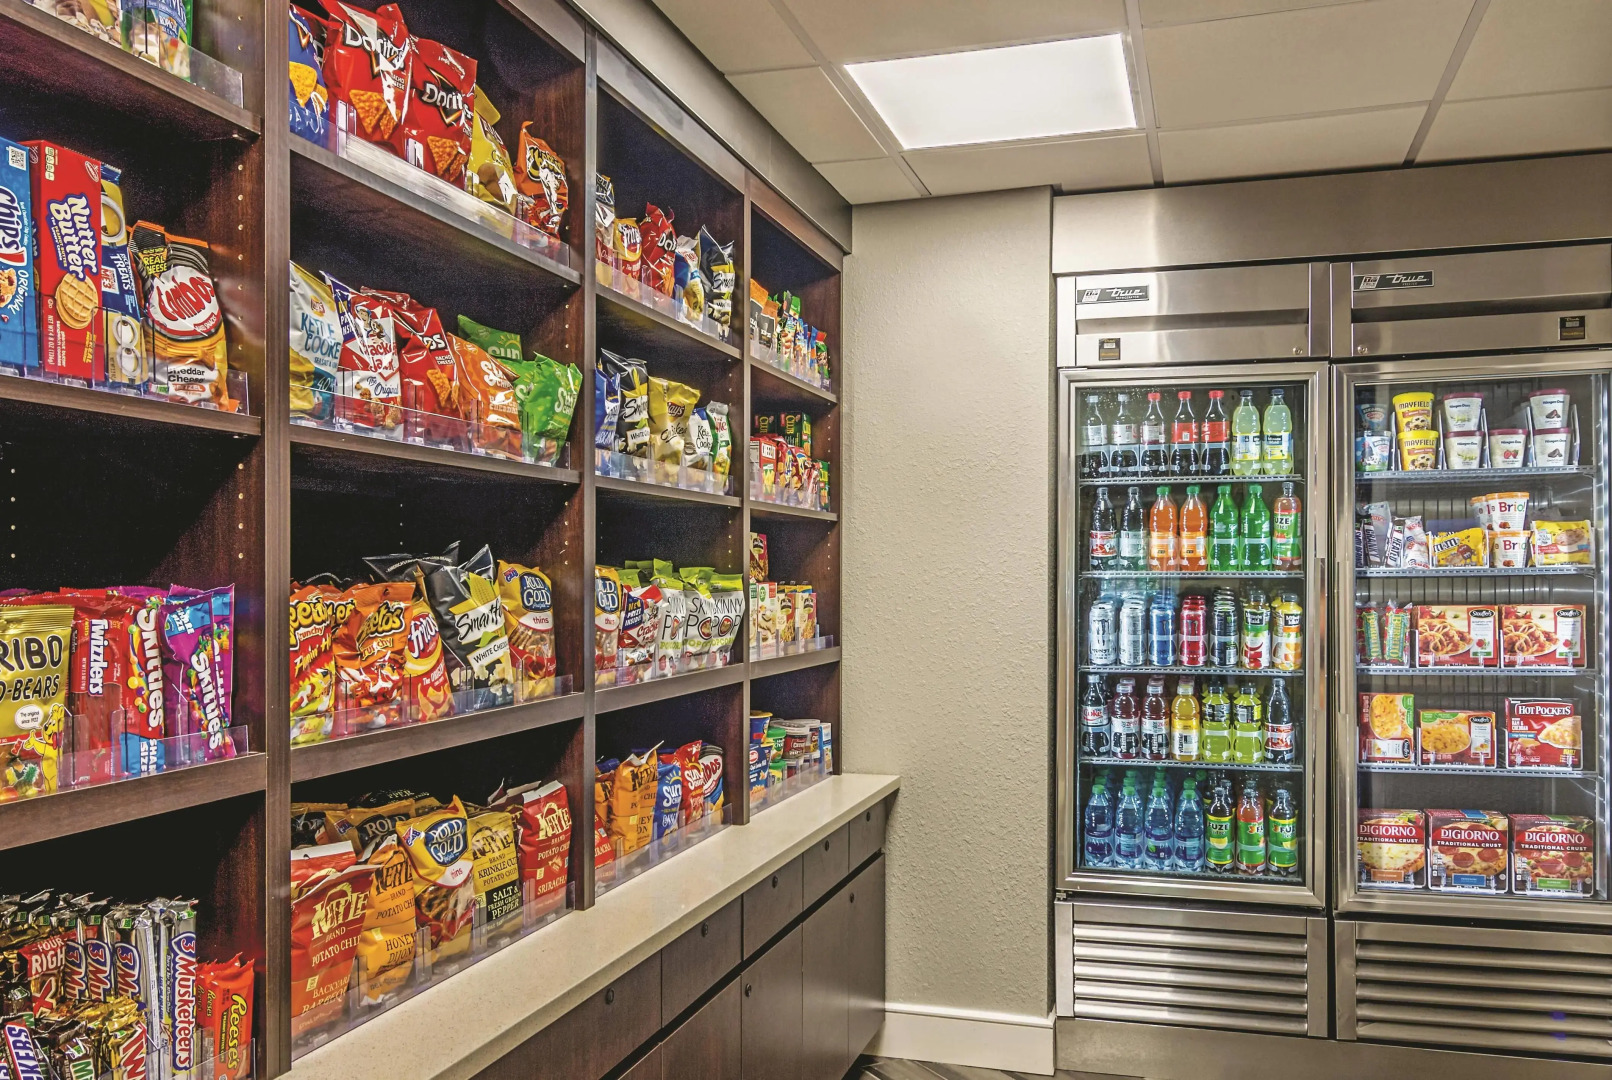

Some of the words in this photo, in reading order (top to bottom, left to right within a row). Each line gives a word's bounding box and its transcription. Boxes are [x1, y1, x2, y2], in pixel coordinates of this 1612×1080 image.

[50, 203, 84, 280] Butter
[68, 196, 97, 274] Nutter
[144, 255, 165, 266] REAL
[147, 262, 167, 276] HEESE
[110, 255, 130, 290] TREATS
[305, 334, 341, 360] COOKE
[1399, 401, 1430, 410] MAYFIELD
[525, 575, 545, 589] ROLD
[524, 590, 551, 606] GOLD
[171, 614, 186, 632] SIZE
[456, 596, 504, 642] Smartf
[533, 616, 550, 625] thins
[1472, 610, 1493, 618] Stouffer's
[1389, 616, 1402, 657] BURRITO
[0, 635, 62, 672] RIBO
[89, 619, 108, 696] Twizzlers
[473, 648, 493, 664] WHITE
[137, 609, 164, 728] Skittles
[0, 675, 60, 702] D-BEARS
[191, 652, 221, 750] Skittles
[1518, 705, 1535, 715] HOT
[1535, 704, 1571, 716] POCKETS
[432, 819, 463, 844] ROLD
[536, 803, 572, 841] KETTLE
[431, 834, 464, 863] GOLD
[537, 846, 559, 861] POTATO
[1437, 840, 1480, 848] TRADITIONAL
[1482, 841, 1502, 849] CRUST
[1521, 843, 1565, 851] TRADITIONAL
[375, 849, 413, 897] KETTL
[478, 862, 507, 879] KRINKLE
[483, 872, 505, 886] POTATO
[493, 889, 512, 902] SALT
[312, 882, 370, 941] KETTLE
[376, 904, 404, 921] POTATO
[404, 899, 415, 912] CHI
[492, 900, 520, 920] PEPPER
[325, 926, 346, 943] BRAND
[68, 949, 80, 963] 3
[88, 943, 104, 962] 3
[180, 938, 195, 954] 3
[312, 945, 340, 967] POTATO
[340, 935, 362, 954] CHIP
[32, 946, 66, 977] RIGH
[117, 947, 133, 966] 3
[177, 956, 196, 1068] Musketeers
[227, 993, 248, 1070] Reese's
